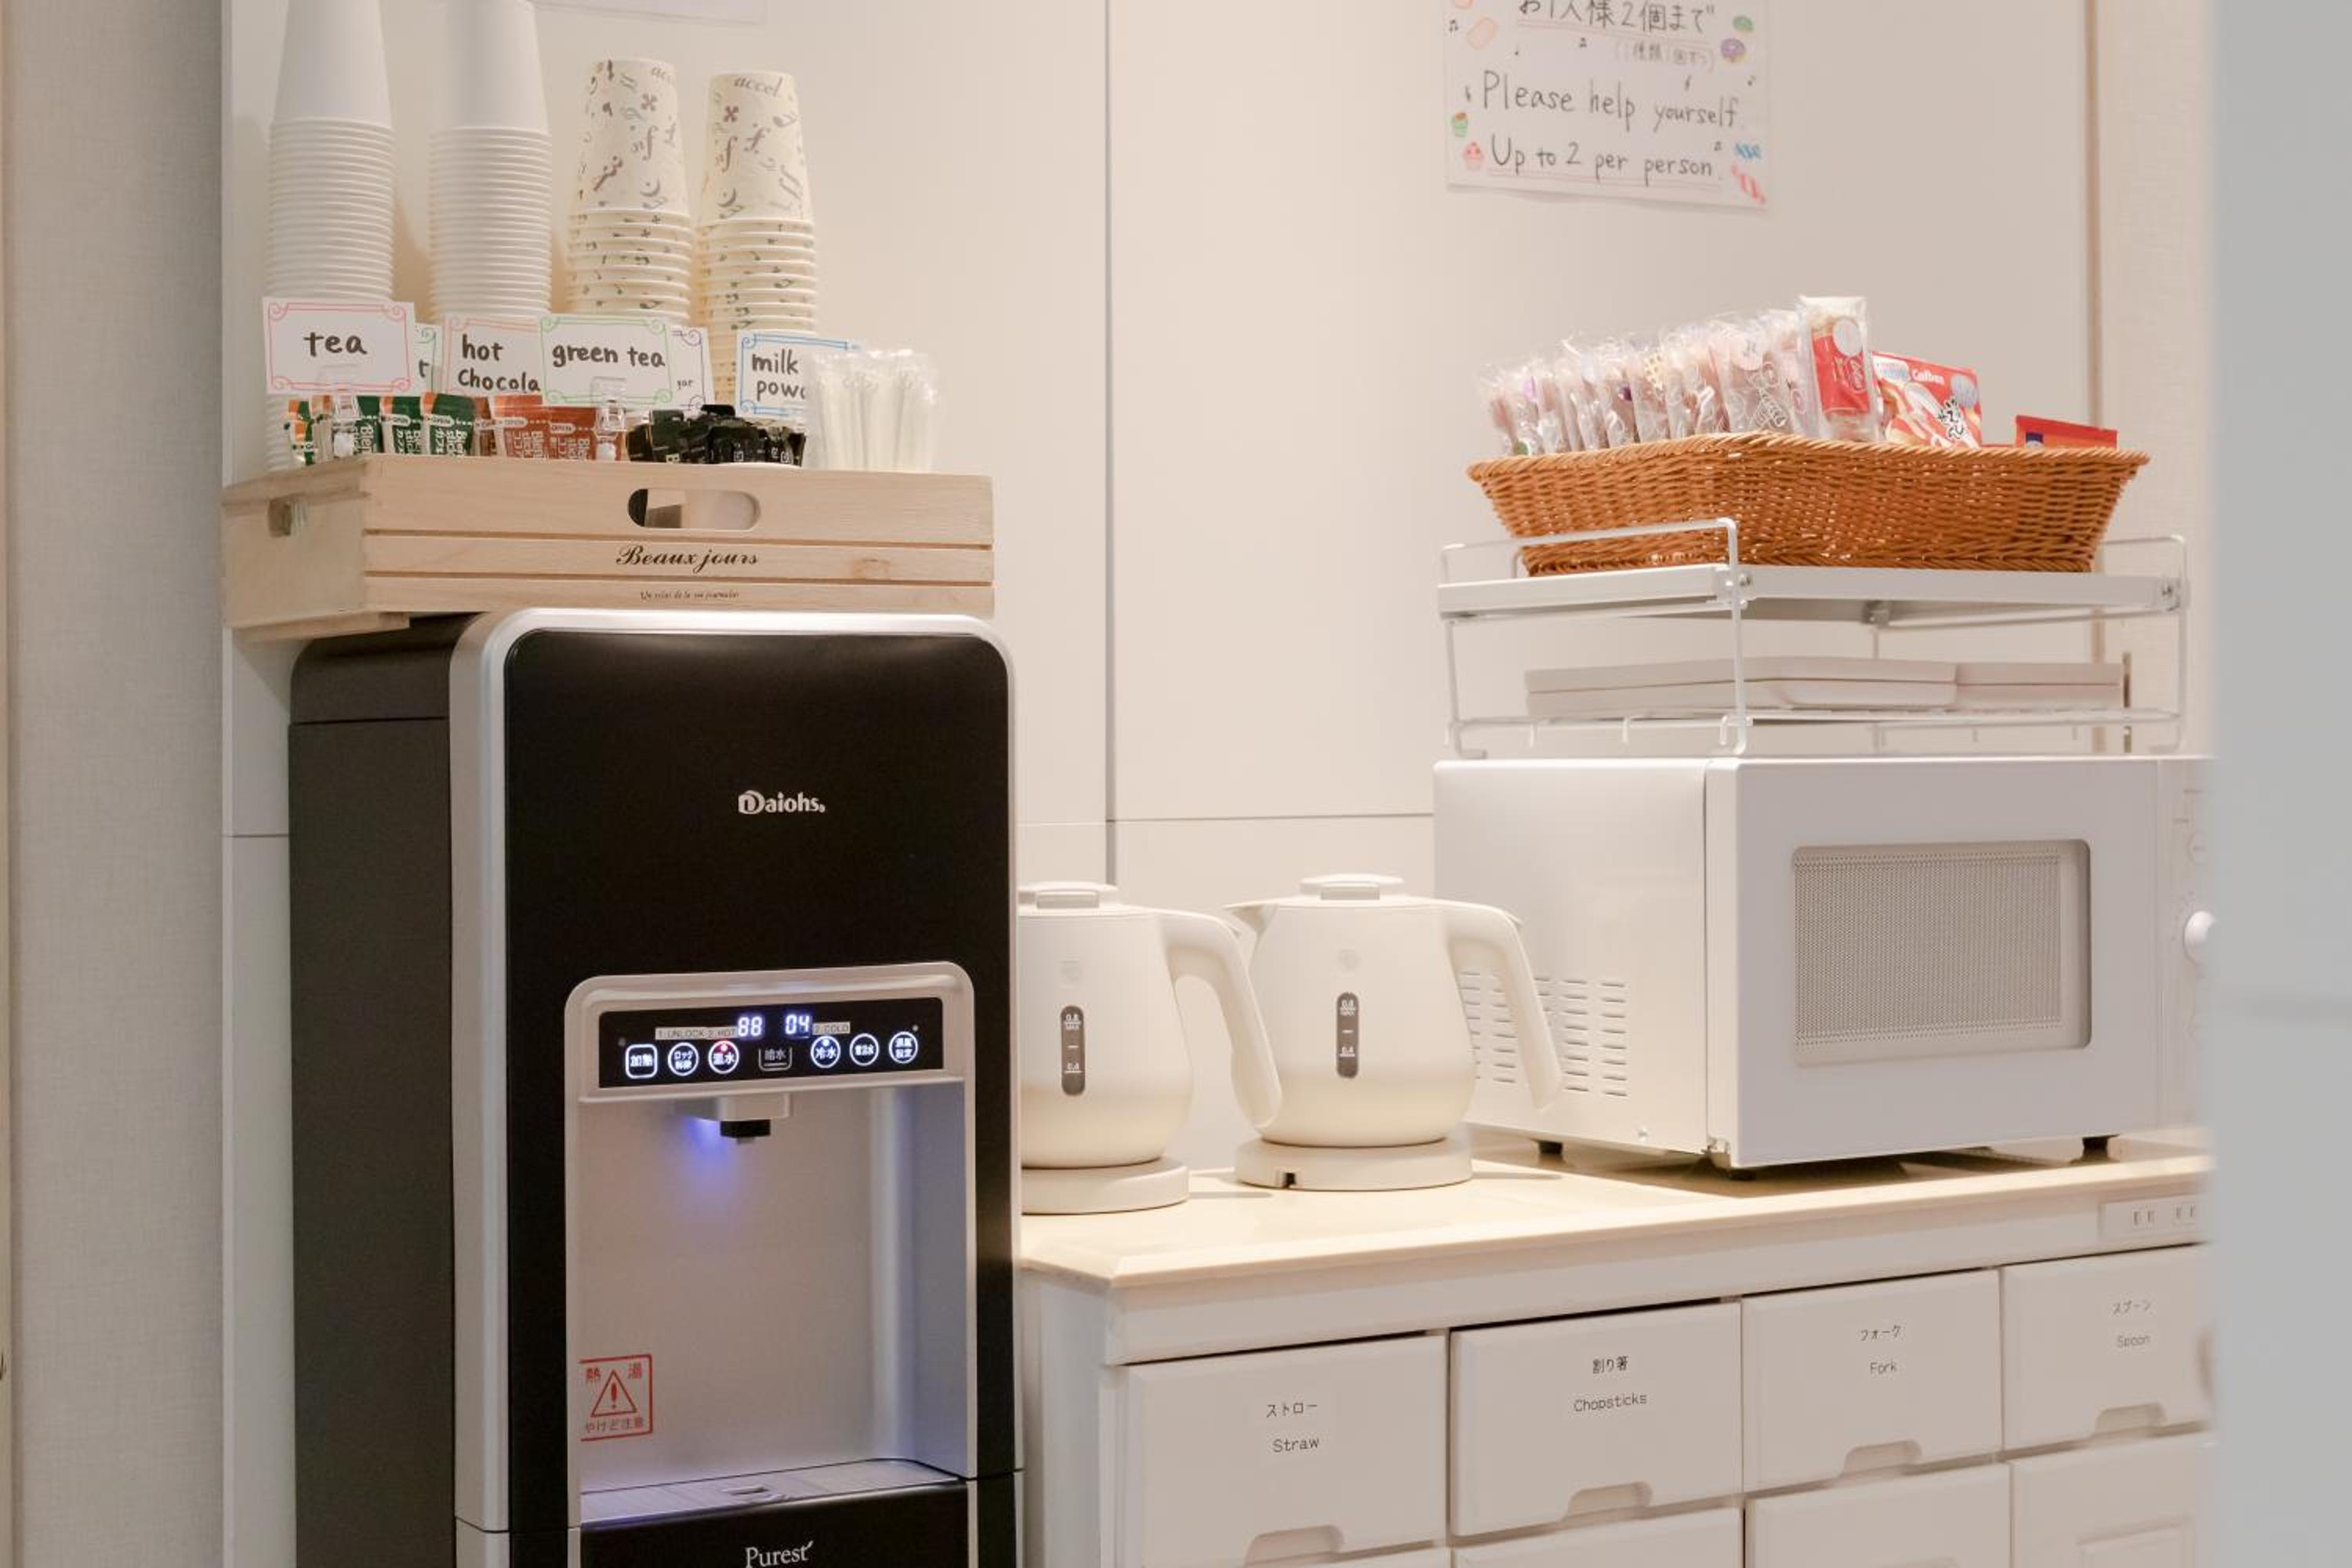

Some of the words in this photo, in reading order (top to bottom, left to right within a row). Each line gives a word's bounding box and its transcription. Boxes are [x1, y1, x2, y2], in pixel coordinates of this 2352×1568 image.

[1483, 70, 1575, 112] Please
[1590, 79, 1636, 132] help
[1491, 133, 1525, 174] Up
[1536, 148, 1558, 168] to
[1566, 141, 1581, 166] 2
[1594, 154, 1628, 183] per
[303, 331, 368, 358] tea
[461, 333, 504, 362] hot
[552, 343, 619, 368] green
[626, 346, 666, 368] tea
[752, 348, 799, 375] milk
[615, 545, 698, 566] Beaux
[692, 548, 758, 575] jours
[738, 1016, 763, 1037] 88
[785, 1014, 811, 1035] 04
[814, 1047, 837, 1059] 冷水
[1592, 1355, 1629, 1374] 割り箸
[1870, 1360, 1897, 1374] Fork
[1265, 1402, 1319, 1418] ストロー
[1573, 1392, 1648, 1412] Chopsticks
[1272, 1437, 1320, 1454] Straw
[745, 1540, 814, 1568] Purest
